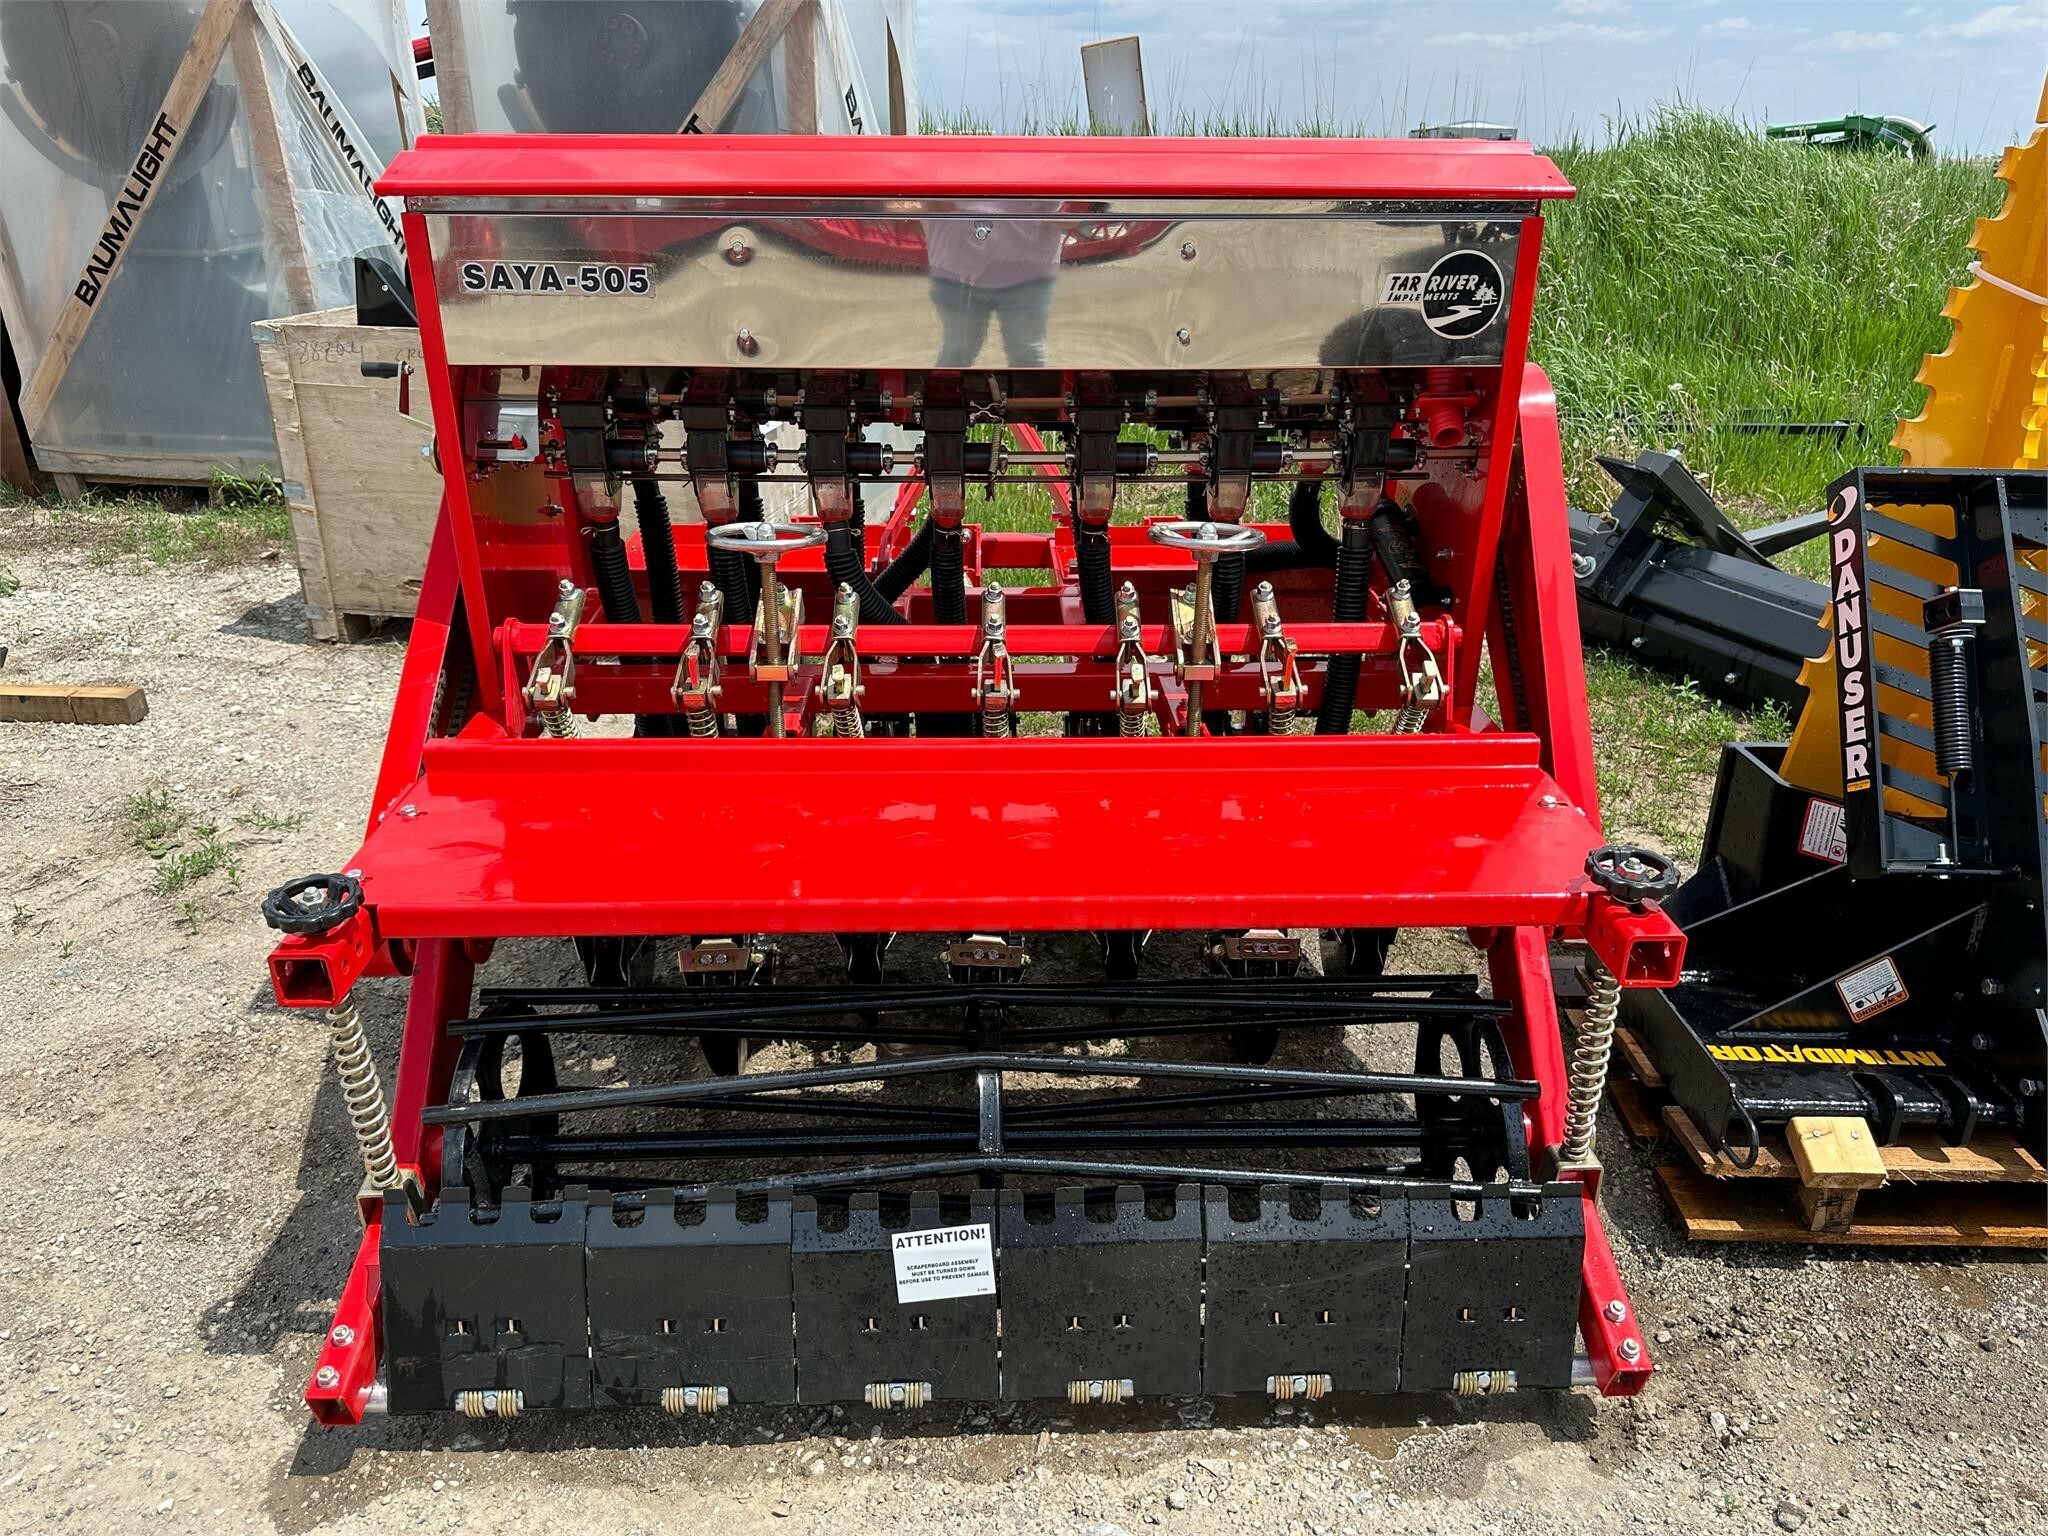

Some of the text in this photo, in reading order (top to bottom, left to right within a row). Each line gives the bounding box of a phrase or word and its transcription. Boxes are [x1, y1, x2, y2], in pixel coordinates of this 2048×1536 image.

[74, 112, 177, 307] BAUMALIGHT
[462, 264, 650, 294] SAYA-505
[1390, 274, 1479, 292] TAR RIVER
[1387, 292, 1459, 302] IMPLEMENTS
[1834, 528, 1870, 780] DANUSER
[1856, 997, 1896, 1018] WARNING
[1706, 1044, 1947, 1066] INTIMIDATOR
[896, 1228, 985, 1249] ATTENTION!
[906, 1258, 979, 1271] SCRAPERBOARD ASSEMBLY
[899, 1277, 920, 1285] BEFORE
